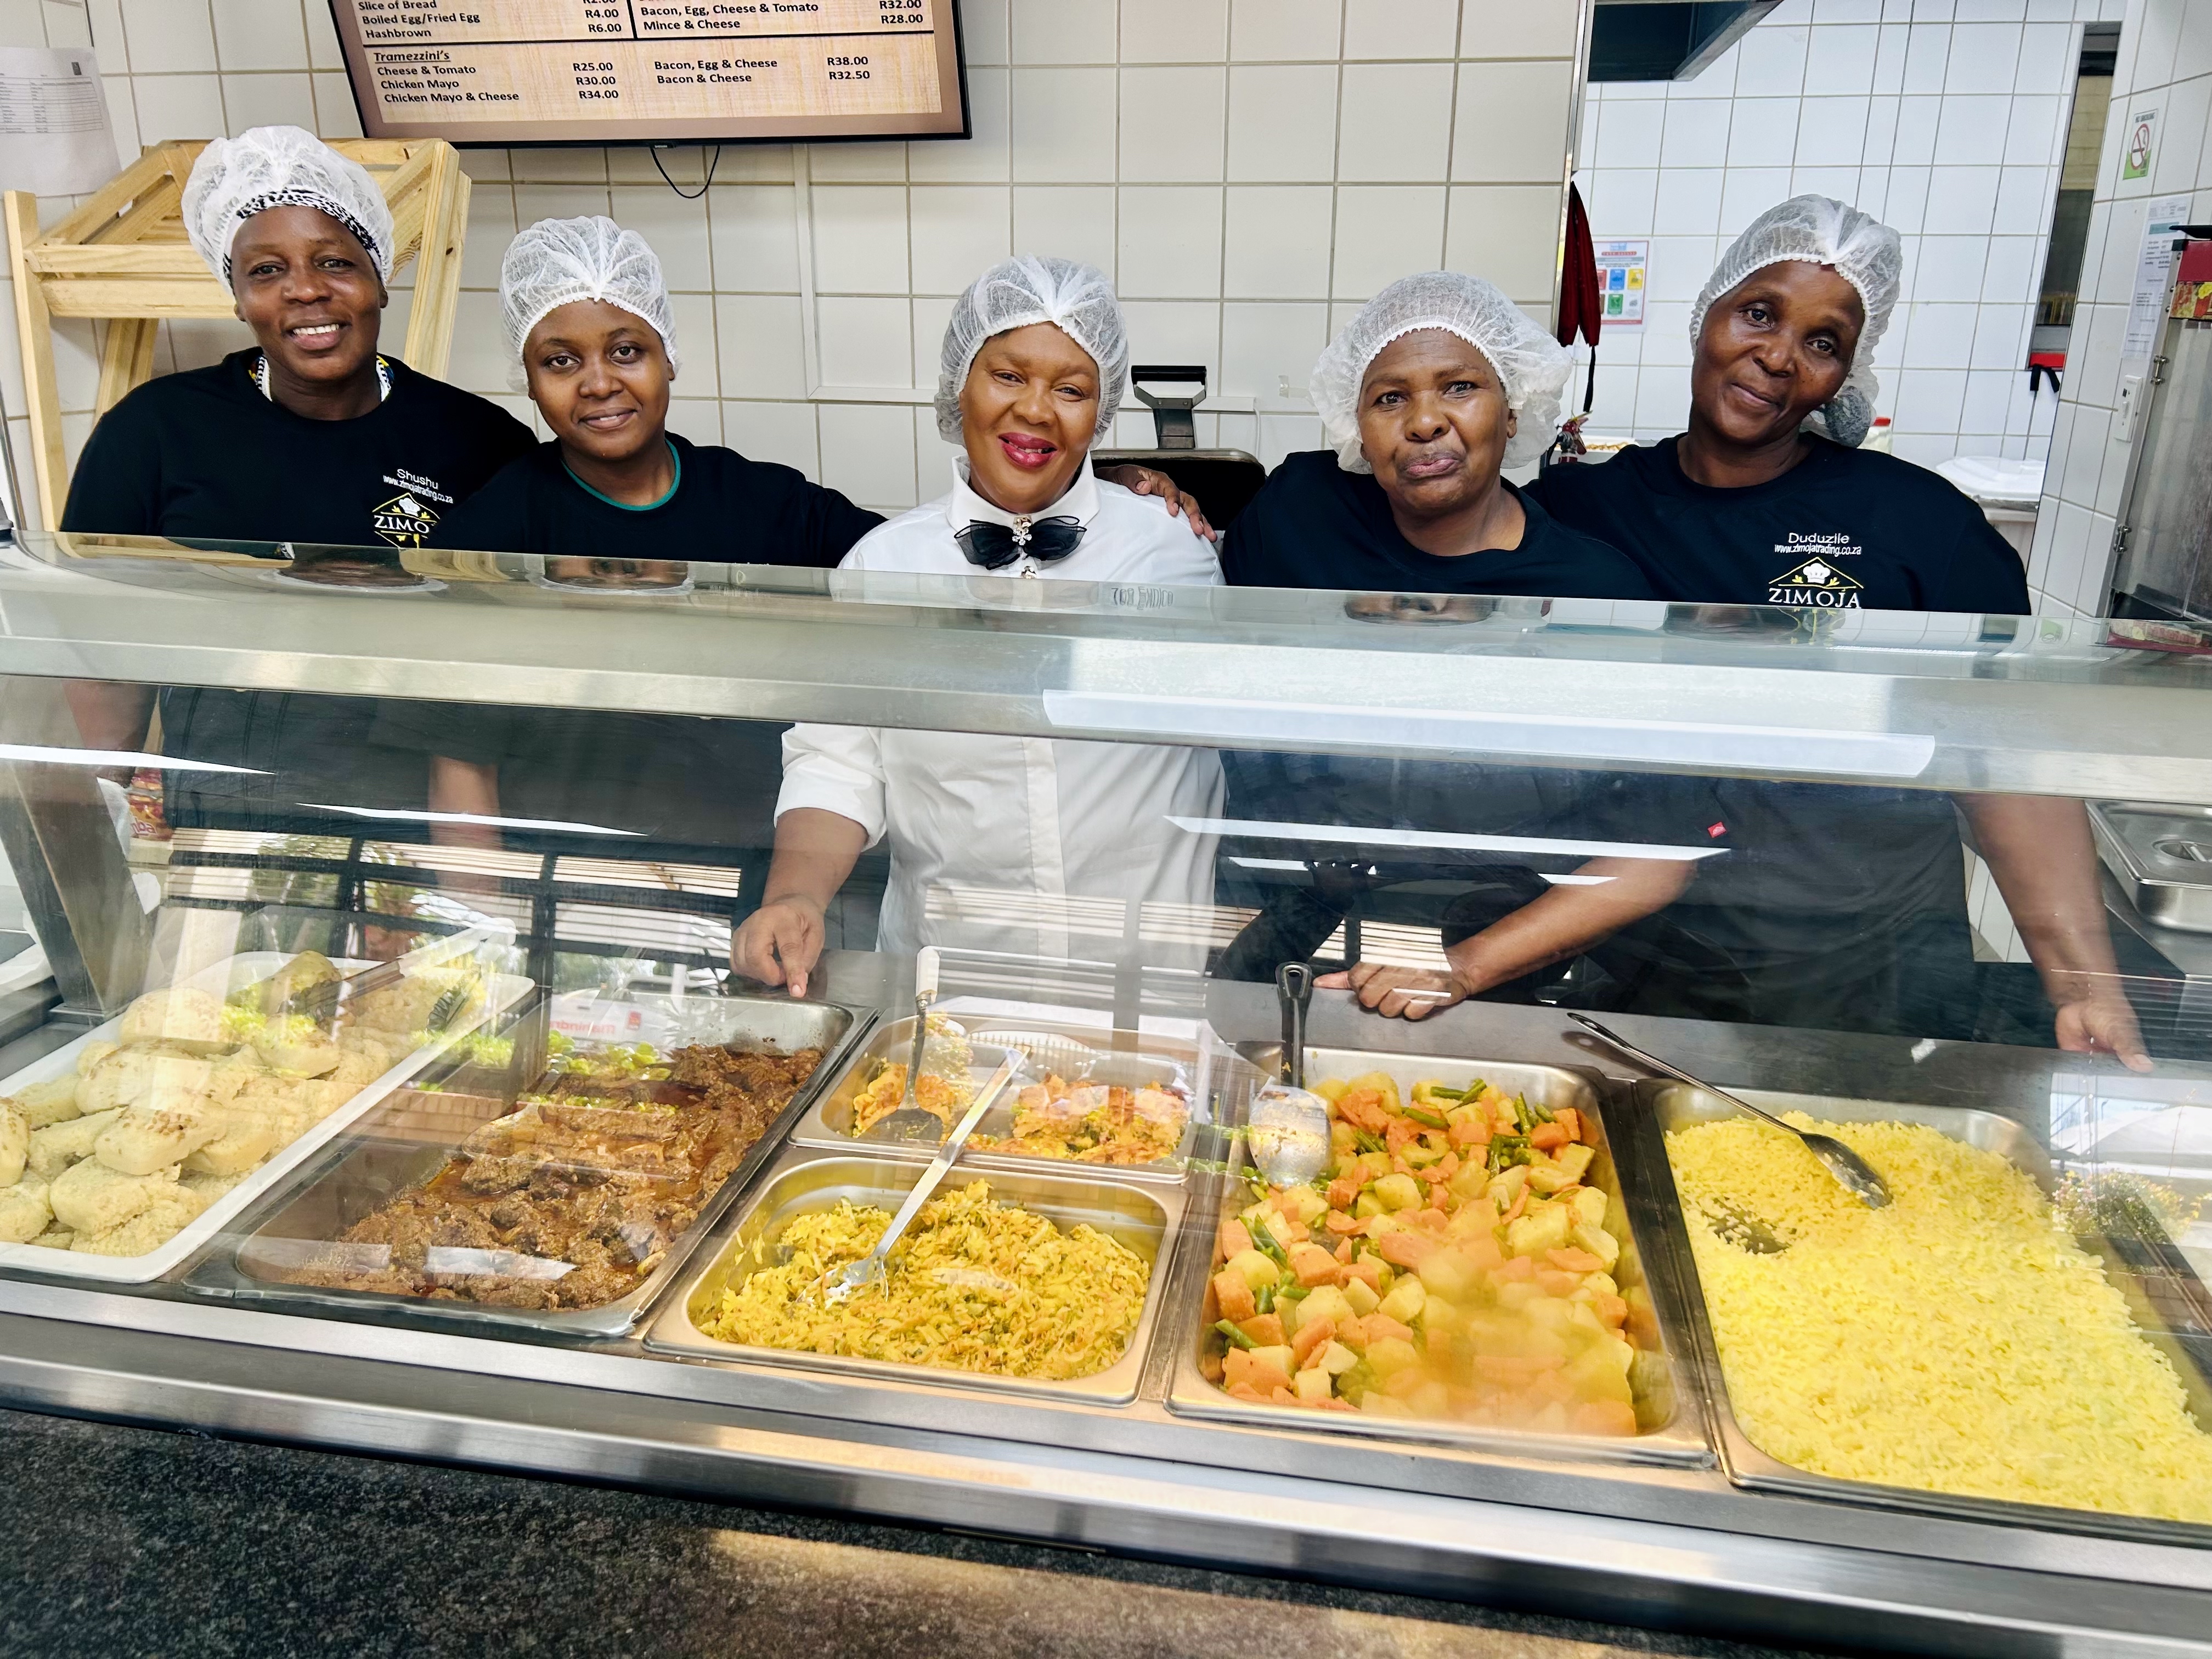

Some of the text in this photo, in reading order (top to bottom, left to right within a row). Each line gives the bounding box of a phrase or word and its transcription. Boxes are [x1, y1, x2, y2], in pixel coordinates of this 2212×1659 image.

[358, 0, 437, 10] Slice of Bread
[641, 3, 818, 16] Bacon, Egg, Cheese & Tomato
[879, 0, 921, 9] R32.00
[585, 9, 618, 18] R4.00
[362, 13, 480, 25] Boiled Egg/Fried Egg
[881, 14, 923, 24] R28.00
[589, 24, 621, 32] R6.00
[644, 20, 740, 30] Mince & Cheese
[365, 29, 431, 38] Hashbrown
[374, 50, 450, 64] Tramezzini's
[827, 57, 868, 65] R38.00
[573, 63, 613, 71] R25.00
[654, 59, 777, 70] Bacon, Egg & Cheese
[377, 67, 417, 75] Cheese
[432, 66, 476, 74] Tomato
[830, 71, 870, 80] R32.50
[710, 74, 751, 82] Cheese
[381, 80, 459, 89] Chicken Mayo
[385, 94, 427, 102] Chicken
[431, 94, 462, 103] Mayo
[479, 92, 519, 100] Cheese
[579, 91, 618, 99] R34.00
[397, 469, 438, 489] Shushu
[374, 515, 435, 534] ZIMO
[1788, 533, 1849, 544] Duduzile
[1768, 588, 1861, 608] ZIMOJA
